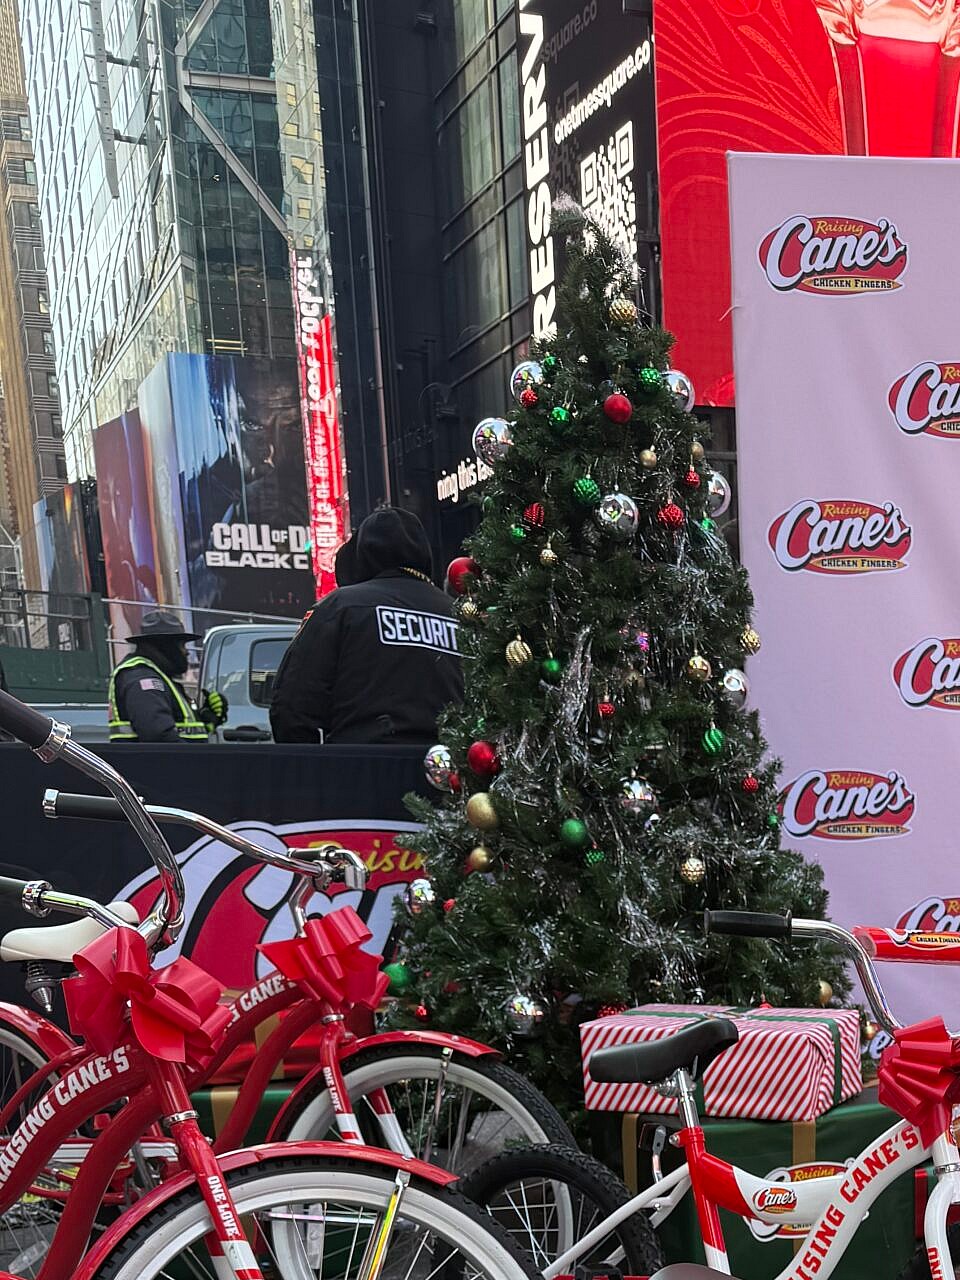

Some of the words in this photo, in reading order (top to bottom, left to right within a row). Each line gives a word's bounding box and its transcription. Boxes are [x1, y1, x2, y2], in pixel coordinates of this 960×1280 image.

[518, 0, 558, 343] RESERV
[816, 221, 864, 236] Raising
[766, 216, 906, 289] Cane's
[814, 278, 851, 288] CHICKEN
[854, 279, 893, 289] FINGERS
[824, 504, 870, 518] Raising
[212, 523, 277, 552] CALL
[271, 530, 288, 543] OF
[776, 500, 911, 569] Cane's
[205, 551, 292, 569] BLACK
[822, 558, 857, 568] CHICKEN
[861, 559, 898, 568] FINGERS
[784, 770, 914, 835] Cane's
[830, 774, 875, 787] Raising
[0, 1095, 56, 1190] AISING
[55, 1046, 129, 1106] CANE'S
[840, 1126, 919, 1203] CANE'S
[207, 1176, 226, 1203] ONE
[218, 1203, 240, 1238] LOVE
